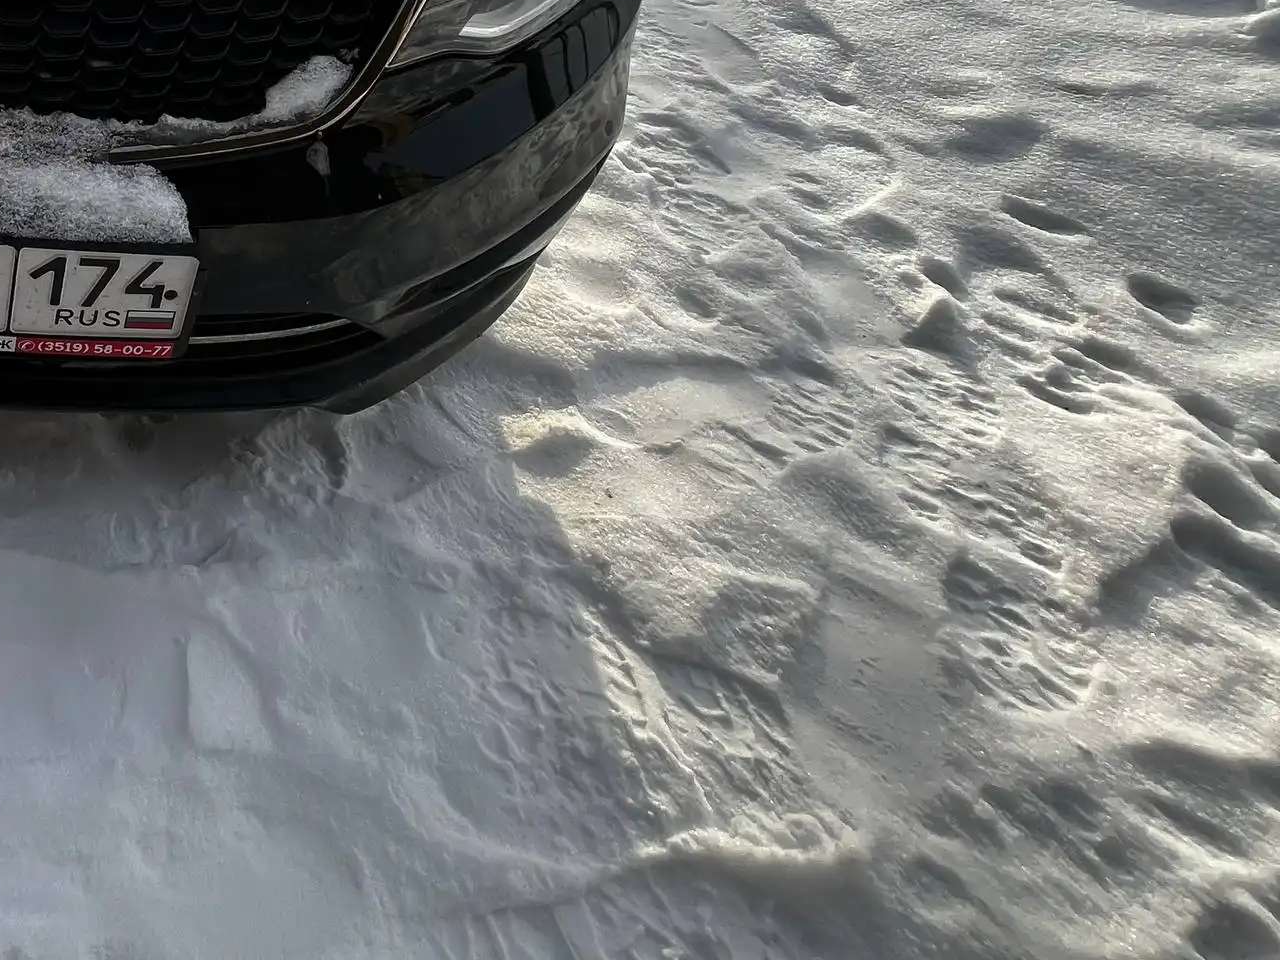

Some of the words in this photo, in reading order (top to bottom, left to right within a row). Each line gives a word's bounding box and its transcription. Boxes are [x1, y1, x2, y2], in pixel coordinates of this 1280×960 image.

[28, 256, 167, 309] 174
[54, 308, 121, 327] RUS
[37, 340, 90, 355] (3519)
[93, 343, 172, 357] 58-00-77
